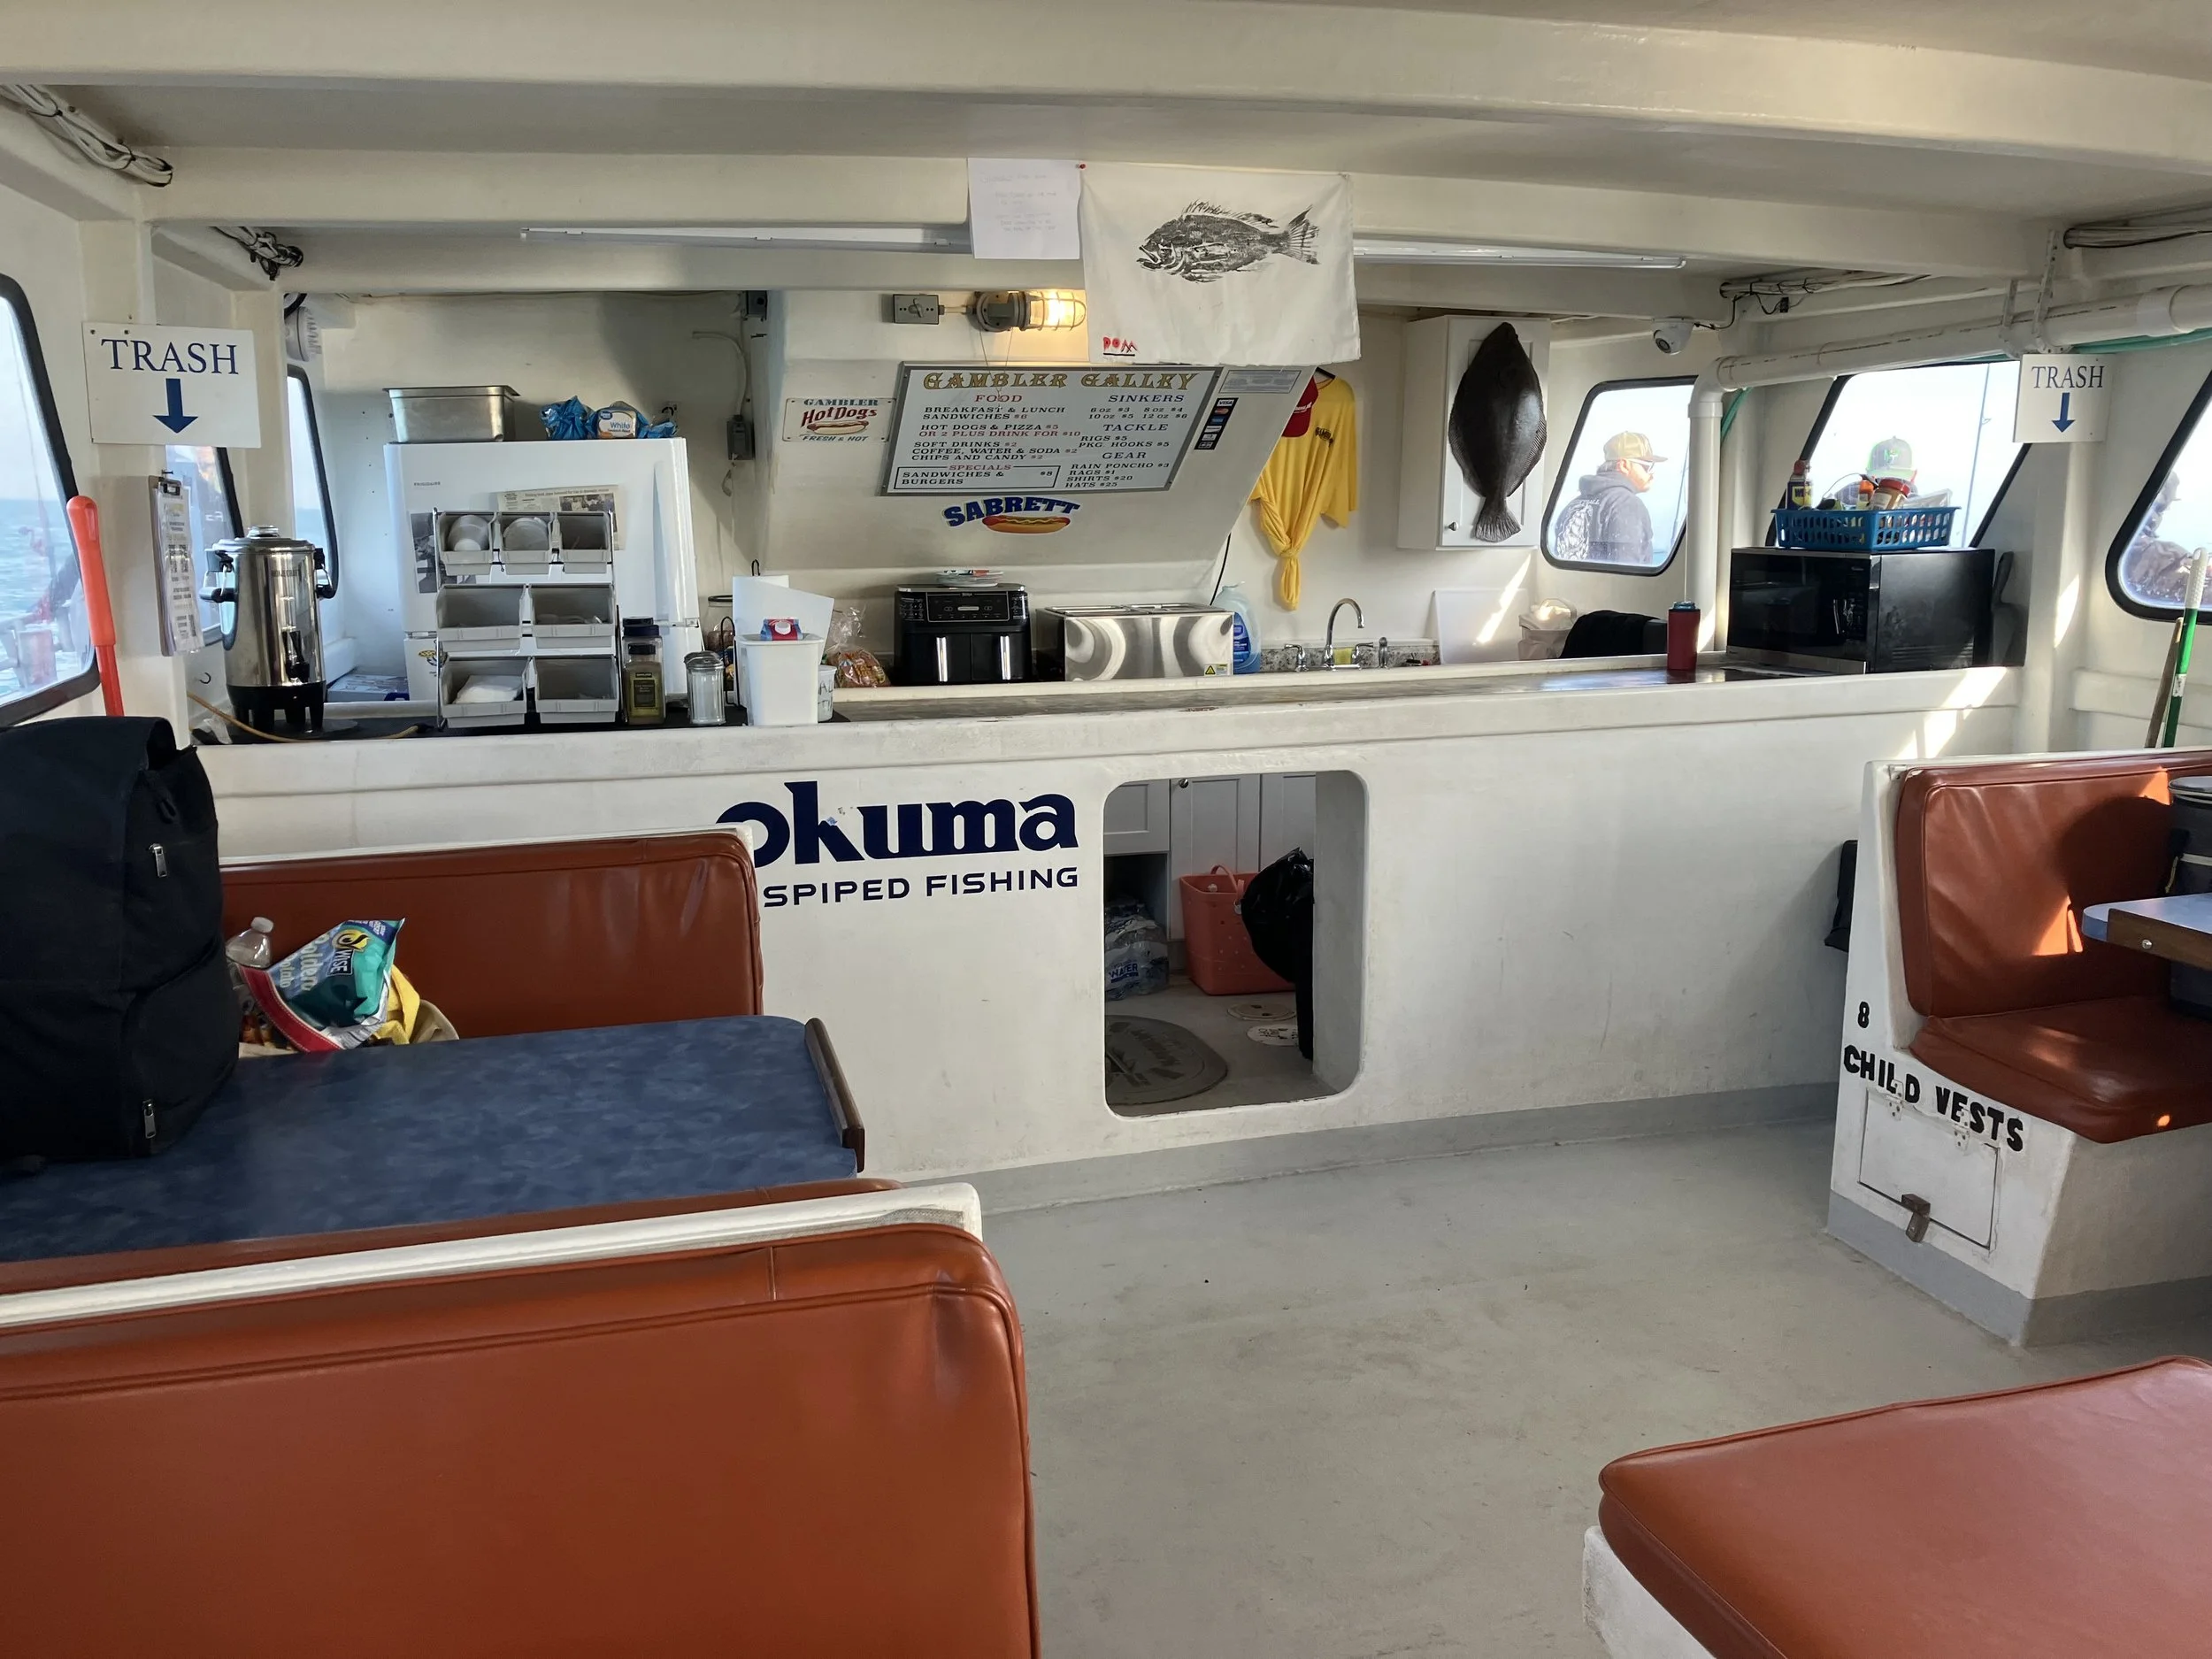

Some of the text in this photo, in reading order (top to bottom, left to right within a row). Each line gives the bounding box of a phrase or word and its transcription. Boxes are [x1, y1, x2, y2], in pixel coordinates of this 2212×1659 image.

[101, 339, 239, 374] TRASH
[924, 373, 1199, 390] GAMBLER GALLEY
[2032, 365, 2105, 388] TRASH
[944, 496, 1080, 526] SABRETT
[715, 781, 1079, 869] okuma
[926, 867, 1078, 897] FISHING
[330, 949, 353, 972] WISE
[1858, 1002, 1870, 1028] 8
[1844, 1045, 2023, 1151] CHILD VESTS
